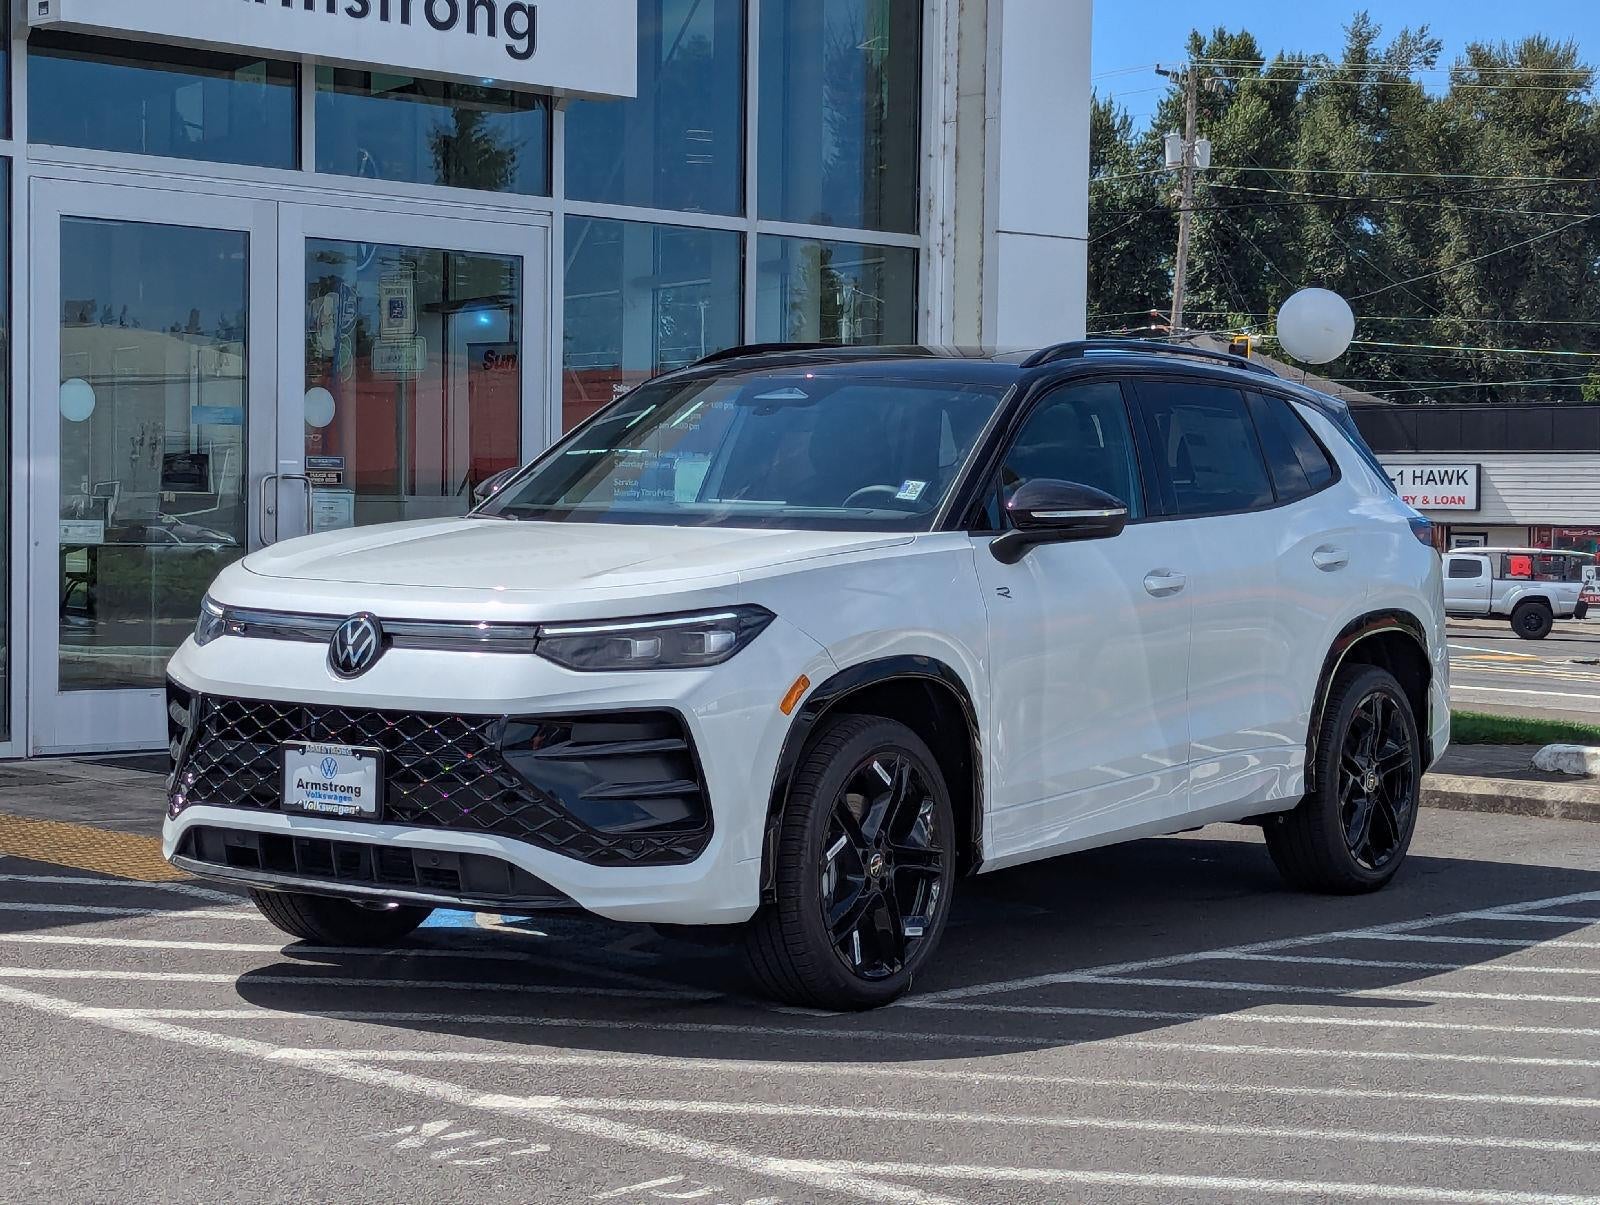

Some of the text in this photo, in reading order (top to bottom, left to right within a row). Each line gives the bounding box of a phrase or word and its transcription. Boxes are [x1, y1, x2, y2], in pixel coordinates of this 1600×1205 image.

[1412, 470, 1469, 486] HAWK
[1402, 495, 1466, 505] RY & LOAN
[296, 778, 361, 797] Armstrong
[305, 790, 353, 803] Volkswagen
[303, 801, 355, 815] Volkswagen
